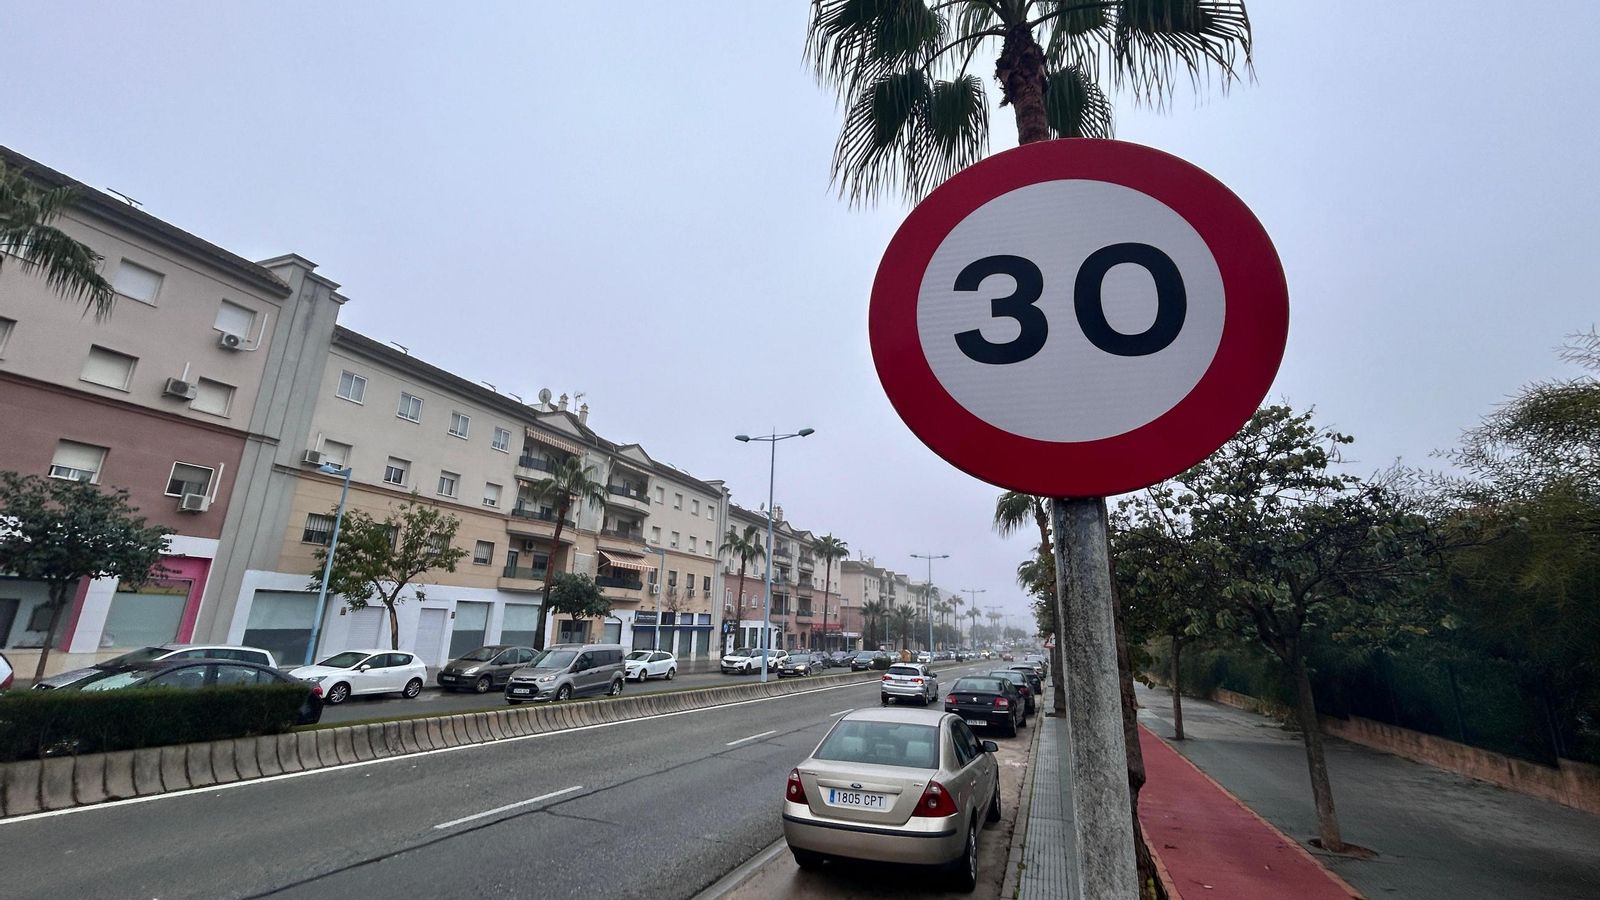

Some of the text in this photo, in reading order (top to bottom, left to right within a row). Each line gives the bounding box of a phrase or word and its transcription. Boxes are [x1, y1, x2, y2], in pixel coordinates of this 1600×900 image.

[953, 242, 1188, 364] 30
[837, 792, 884, 806] 1805 CPT
